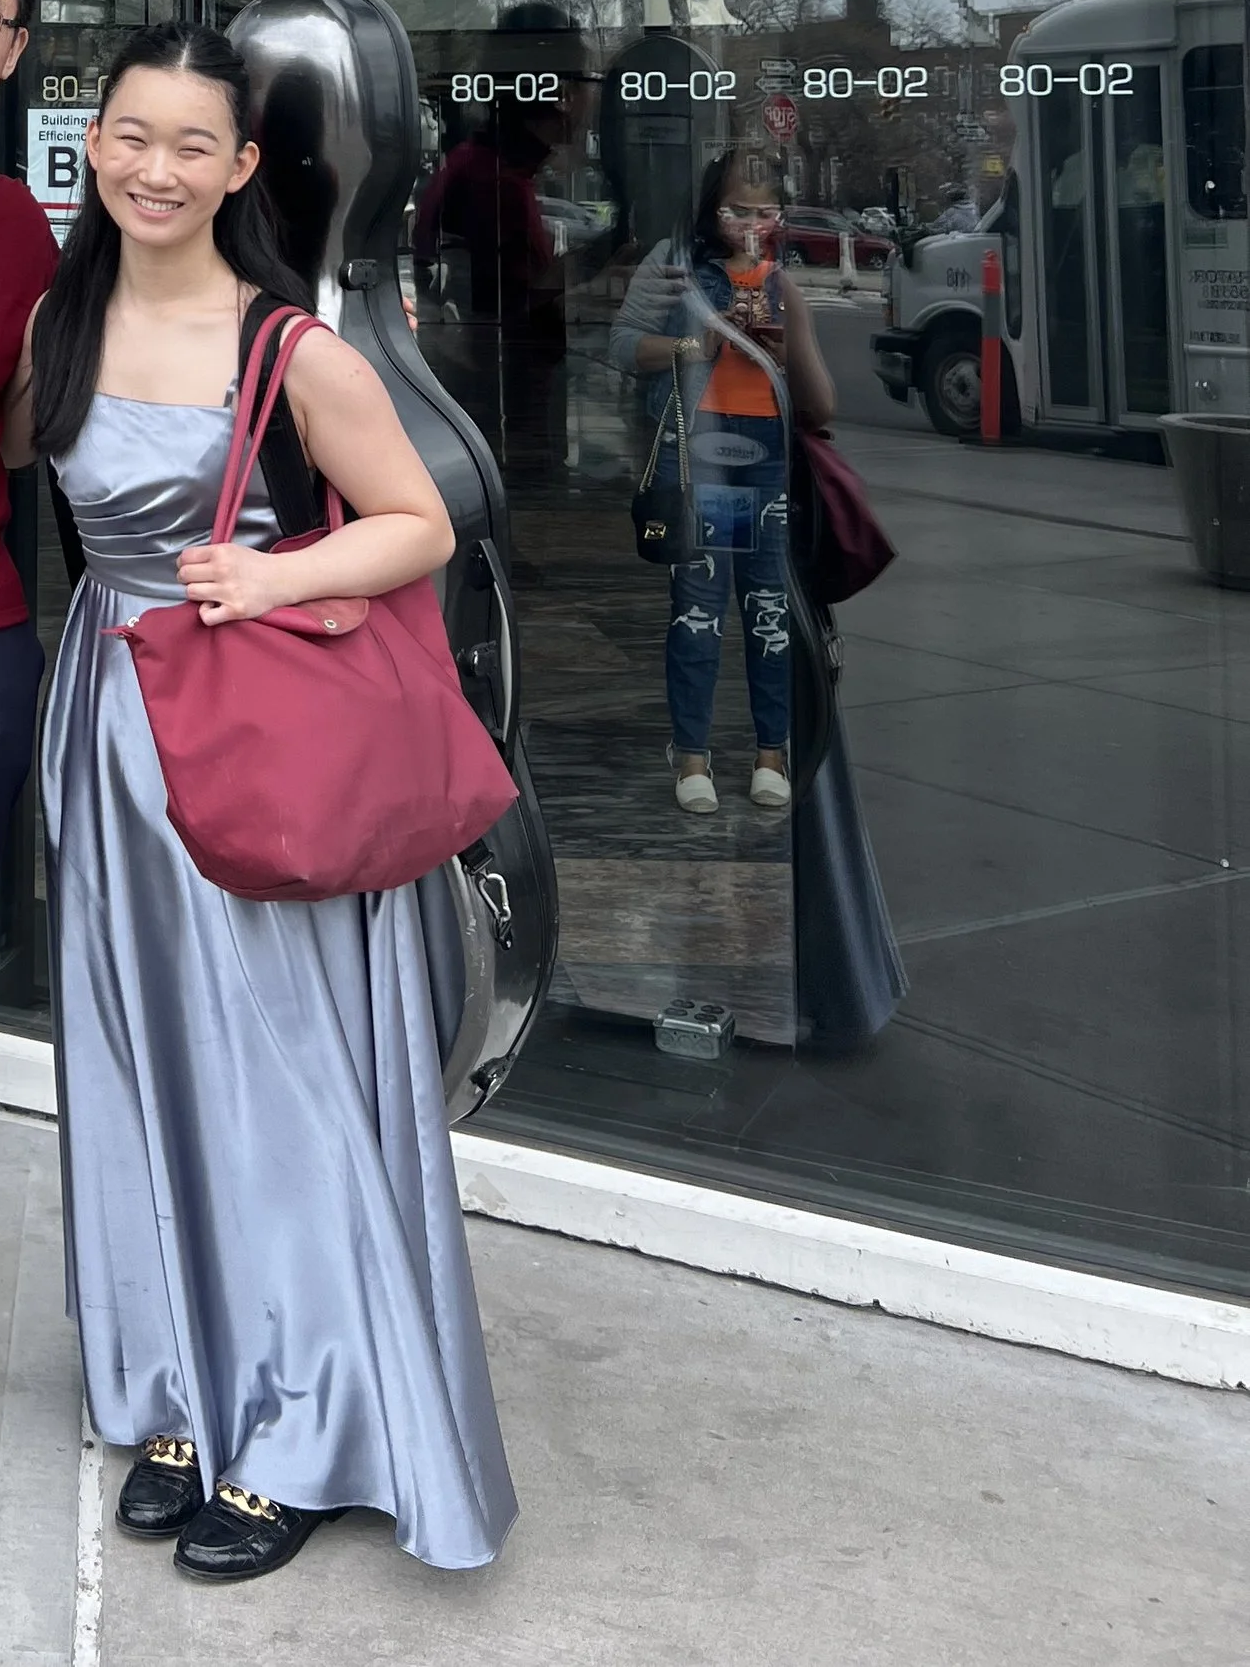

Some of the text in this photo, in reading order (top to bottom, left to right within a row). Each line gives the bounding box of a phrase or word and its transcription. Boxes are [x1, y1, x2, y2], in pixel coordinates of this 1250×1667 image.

[42, 75, 109, 102] 80-
[451, 72, 559, 103] 80-02
[620, 70, 737, 101] 80-02
[803, 66, 929, 99] 80-02
[999, 62, 1135, 97] 80-02
[38, 130, 86, 142] Efficienc
[41, 114, 88, 128] Building
[48, 145, 79, 188] B
